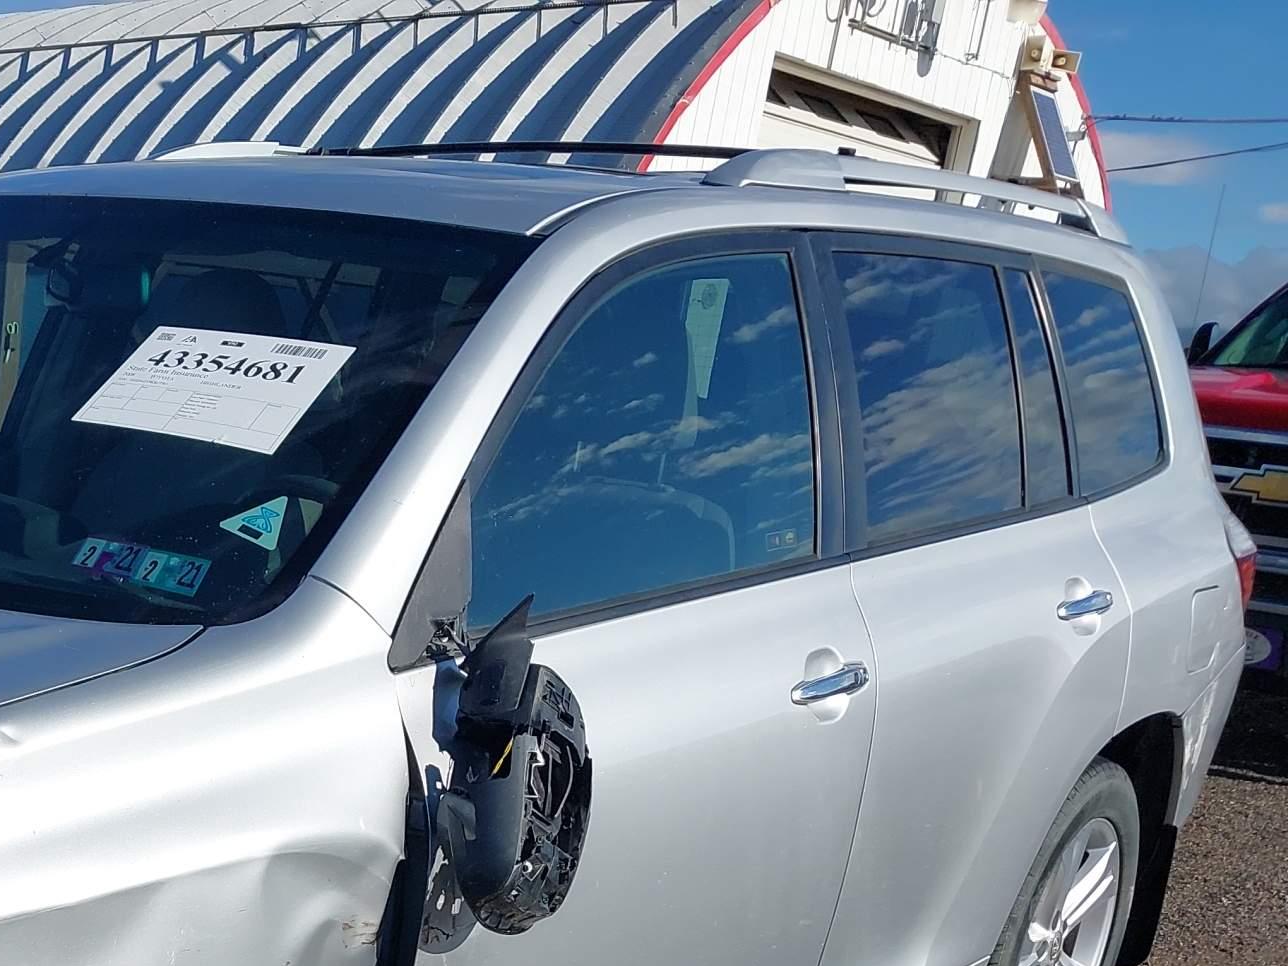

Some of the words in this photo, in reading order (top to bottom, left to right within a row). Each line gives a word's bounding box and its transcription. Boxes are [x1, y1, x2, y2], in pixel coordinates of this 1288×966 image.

[148, 349, 306, 384] 43354681
[148, 366, 169, 374] Farm
[170, 369, 209, 379] Insurance
[114, 546, 142, 571] 21
[175, 560, 203, 588] 21
